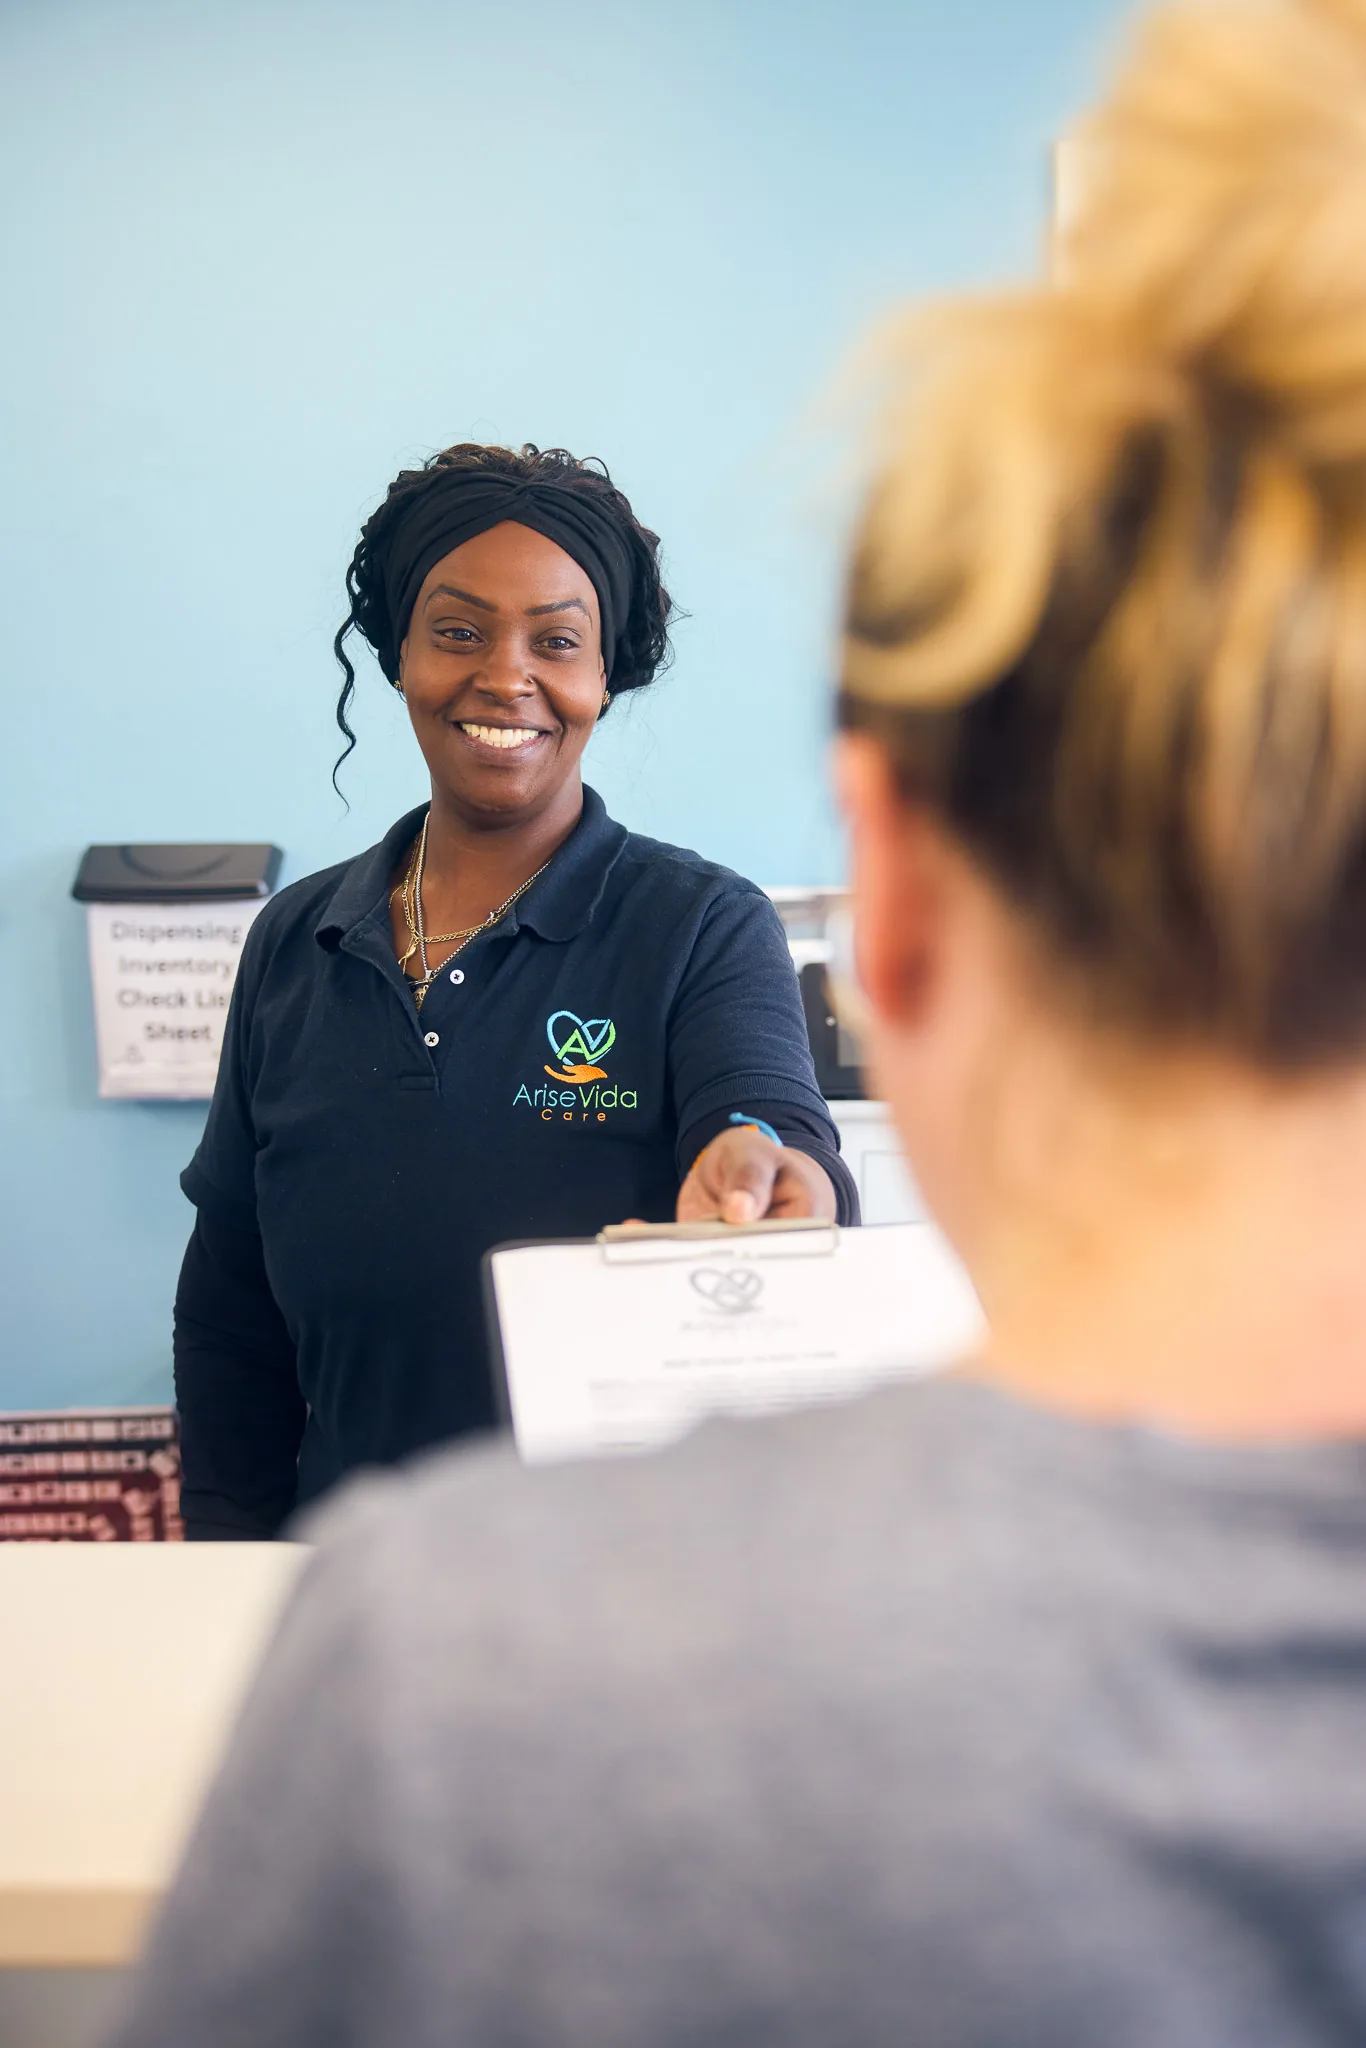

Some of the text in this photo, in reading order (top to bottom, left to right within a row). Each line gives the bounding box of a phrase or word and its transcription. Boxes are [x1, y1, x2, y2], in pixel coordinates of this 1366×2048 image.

[111, 921, 242, 945] Dispensing
[120, 956, 231, 979] Inventory
[117, 988, 231, 1008] Check Lis
[145, 1023, 212, 1042] Sheet
[541, 1109, 606, 1122] Care
